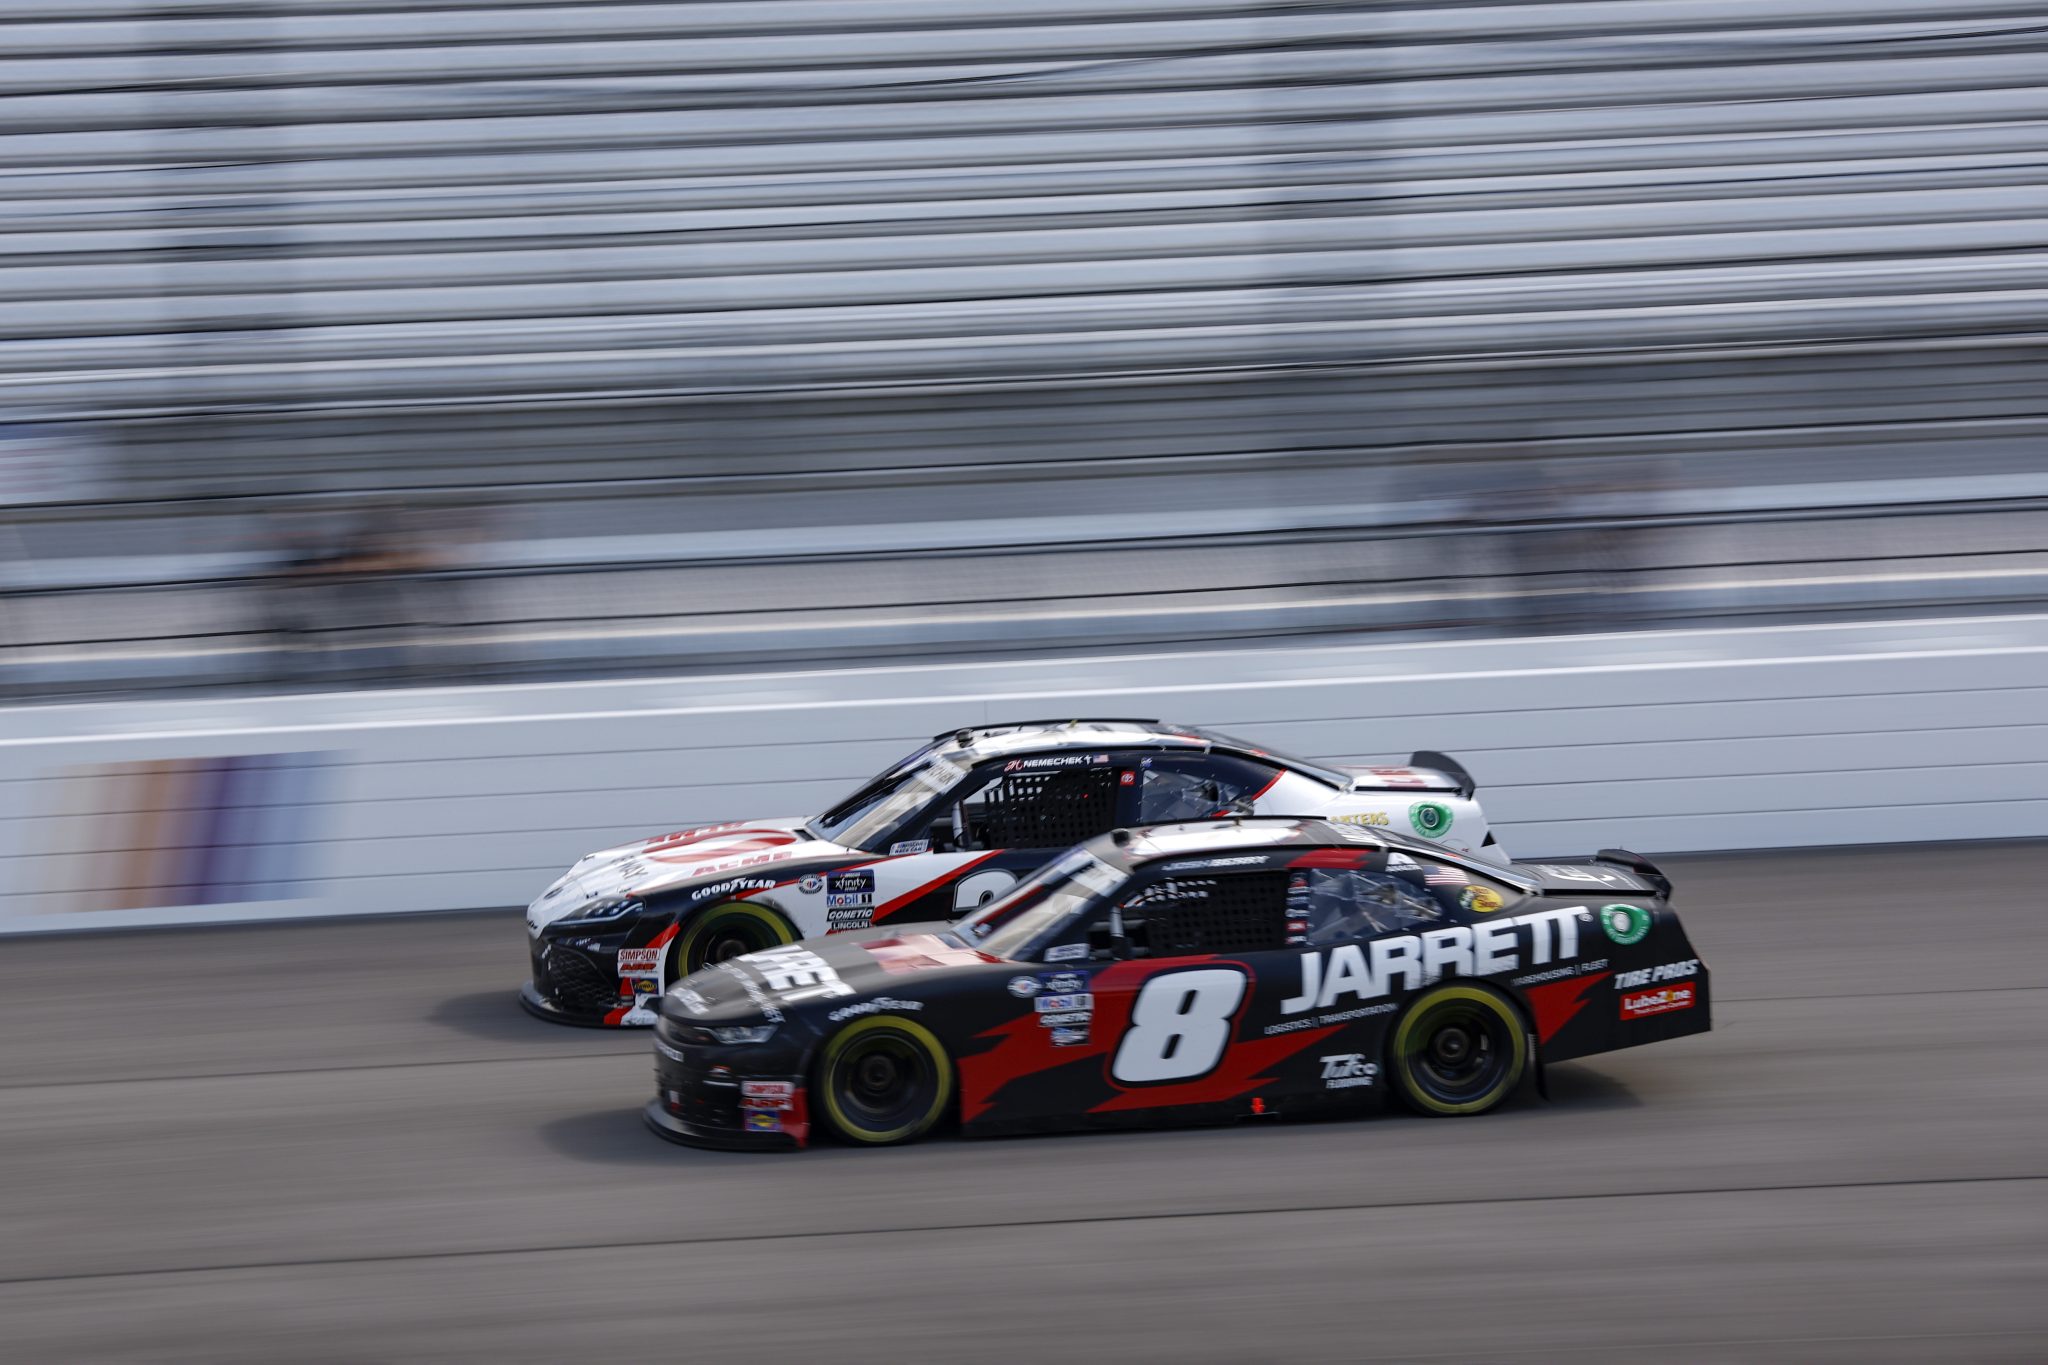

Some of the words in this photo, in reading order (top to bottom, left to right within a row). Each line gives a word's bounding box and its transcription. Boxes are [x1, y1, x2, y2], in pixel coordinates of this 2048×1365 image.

[1023, 756, 1083, 768] NEMECHEK
[691, 877, 776, 901] GOODYEAR
[835, 877, 867, 890] xfinity
[827, 893, 858, 906] Mobil
[833, 921, 868, 930] LINCOLN
[620, 950, 658, 960] SIMPSON
[1281, 905, 1579, 1015] JARRETT
[1614, 968, 1652, 989] TIRE
[1651, 959, 1699, 982] PROS
[1112, 969, 1248, 1083] 8
[1264, 1018, 1312, 1035] LOGISTICS
[1319, 1002, 1399, 1025] TRANSPORTATION
